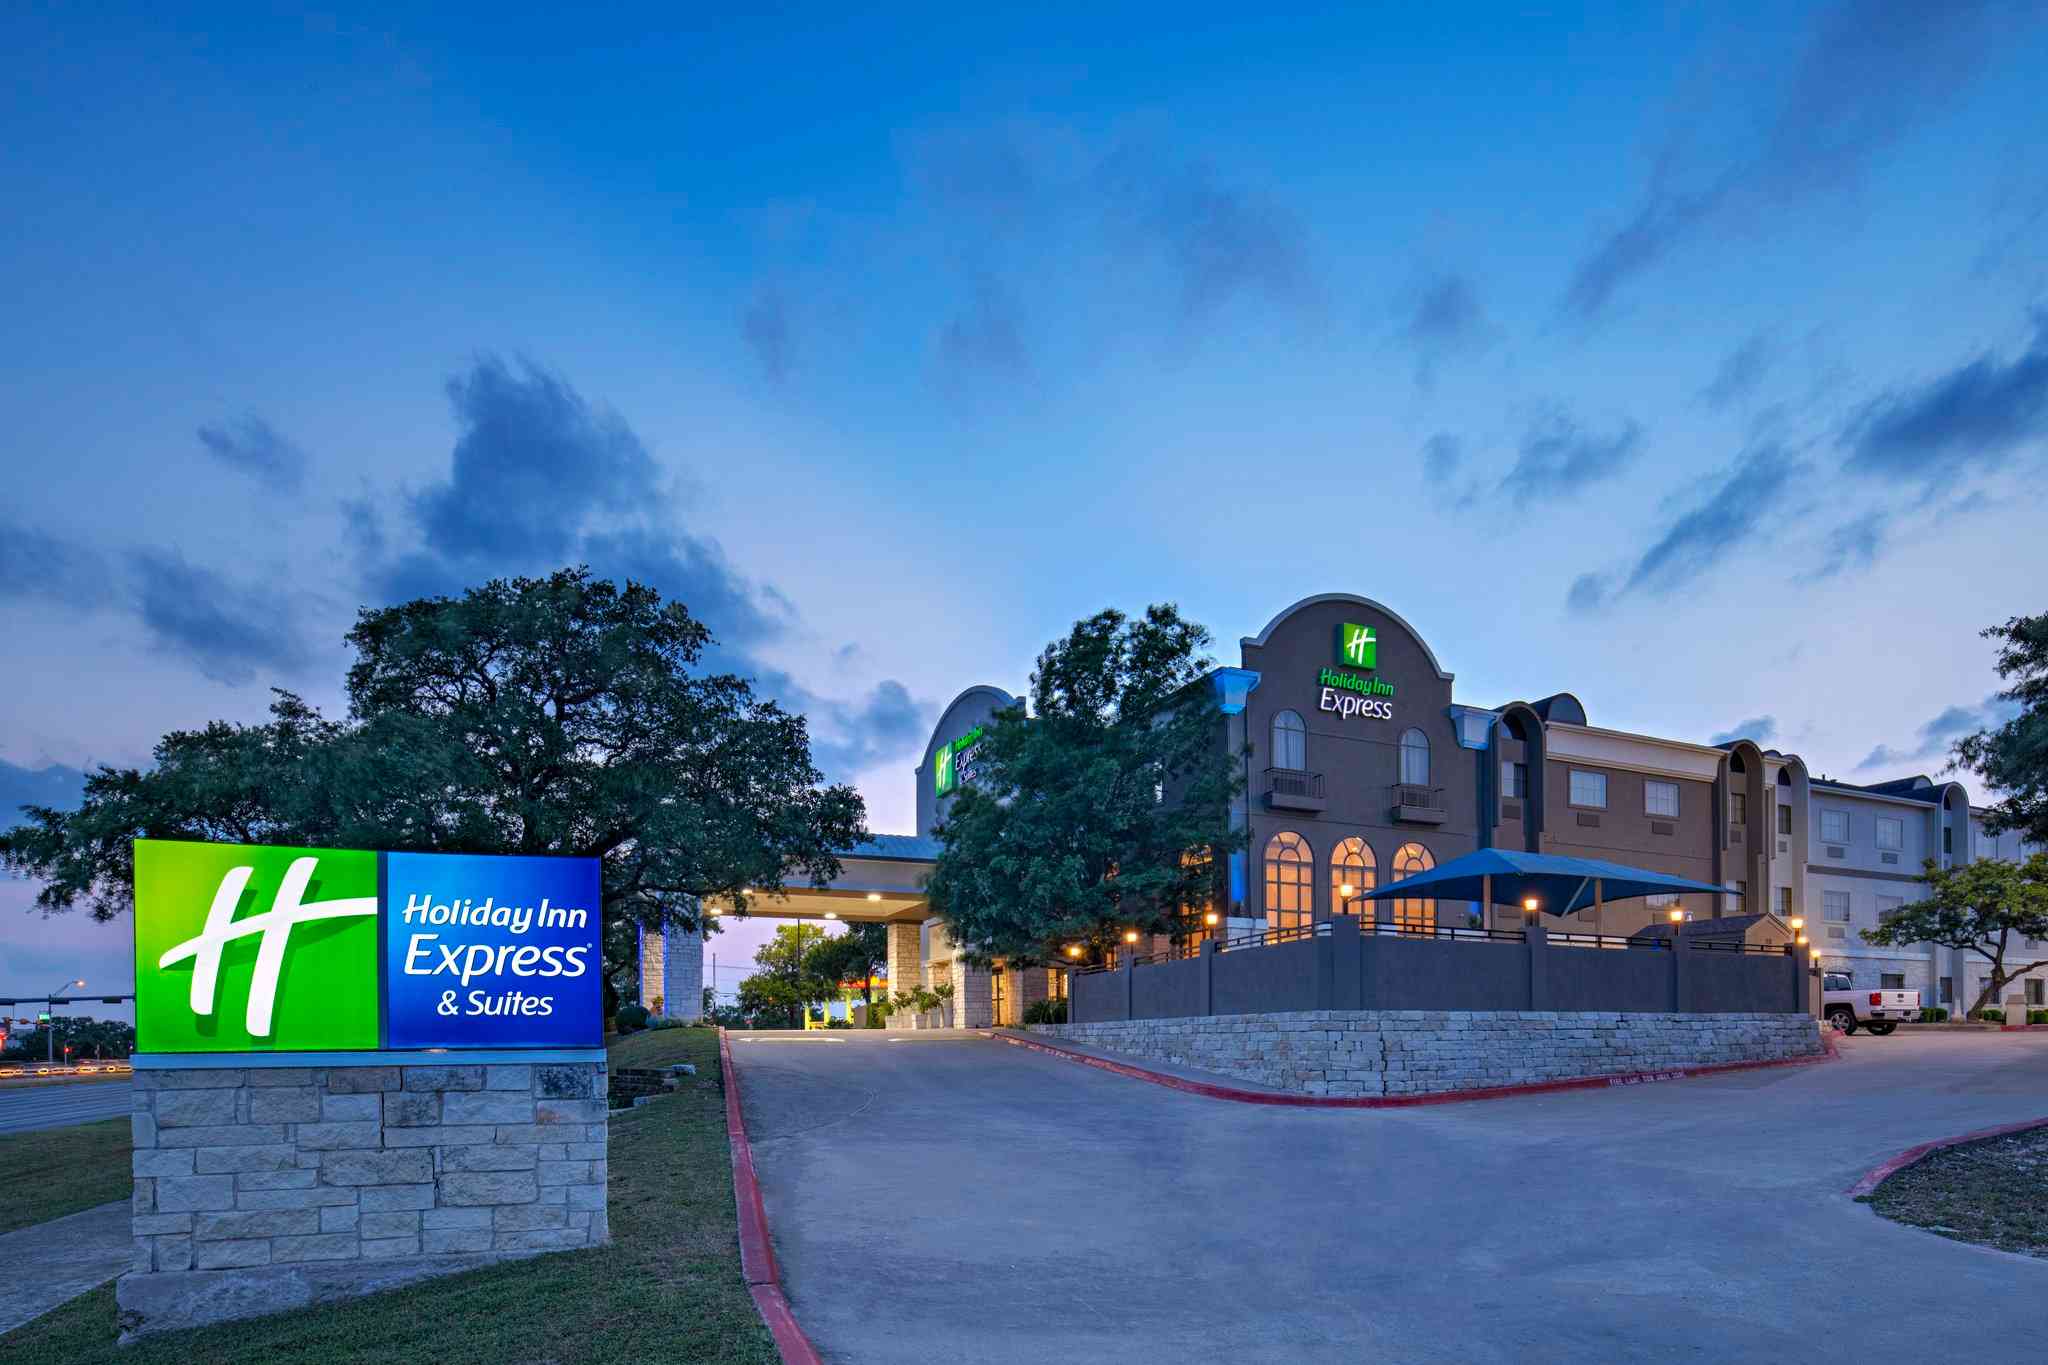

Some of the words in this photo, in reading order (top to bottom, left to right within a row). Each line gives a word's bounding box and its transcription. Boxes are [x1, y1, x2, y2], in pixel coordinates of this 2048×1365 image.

[1320, 668, 1372, 696] Holiday
[1373, 677, 1394, 696] Inn
[1320, 688, 1392, 720] Express
[402, 894, 533, 935] Holiday
[537, 898, 588, 929] Inn
[404, 933, 588, 987] Express
[437, 990, 459, 1016] &
[465, 990, 554, 1017] Suites
